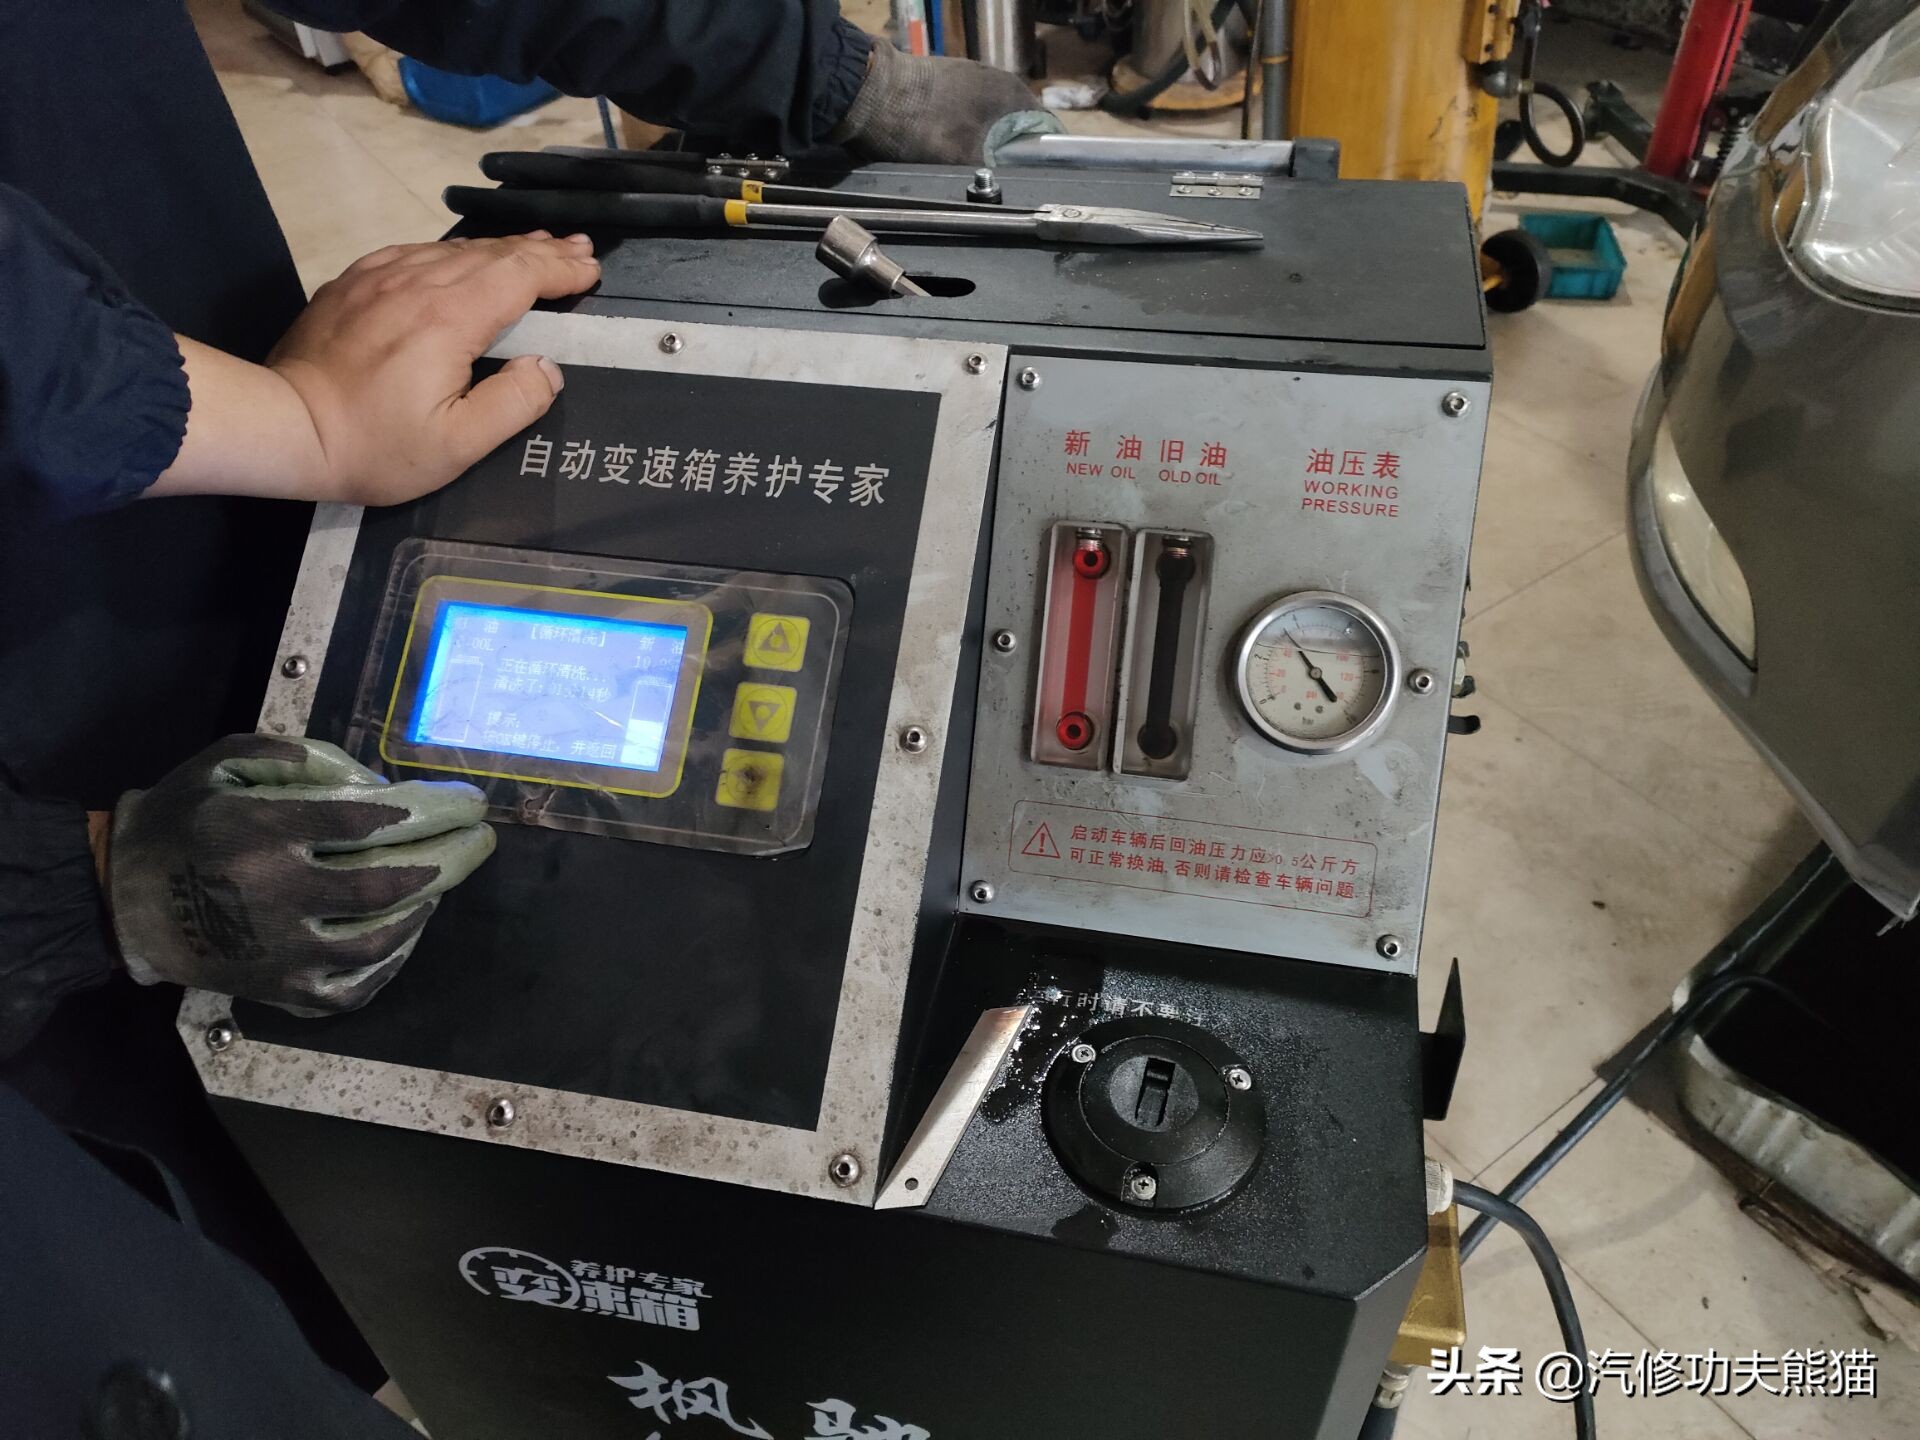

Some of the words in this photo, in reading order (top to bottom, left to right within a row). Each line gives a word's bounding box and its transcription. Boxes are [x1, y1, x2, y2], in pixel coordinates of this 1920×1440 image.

[519, 433, 890, 507] 自动变速箱养护专家
[1066, 461, 1103, 478] NEW
[1111, 465, 1136, 480] OIL
[1159, 469, 1191, 484] OLD
[1195, 471, 1222, 486] OIL
[1305, 448, 1401, 480] 油压表
[1303, 480, 1399, 500] WORKING
[1301, 498, 1399, 518] PRESSURE
[570, 1259, 713, 1299] 养护专家
